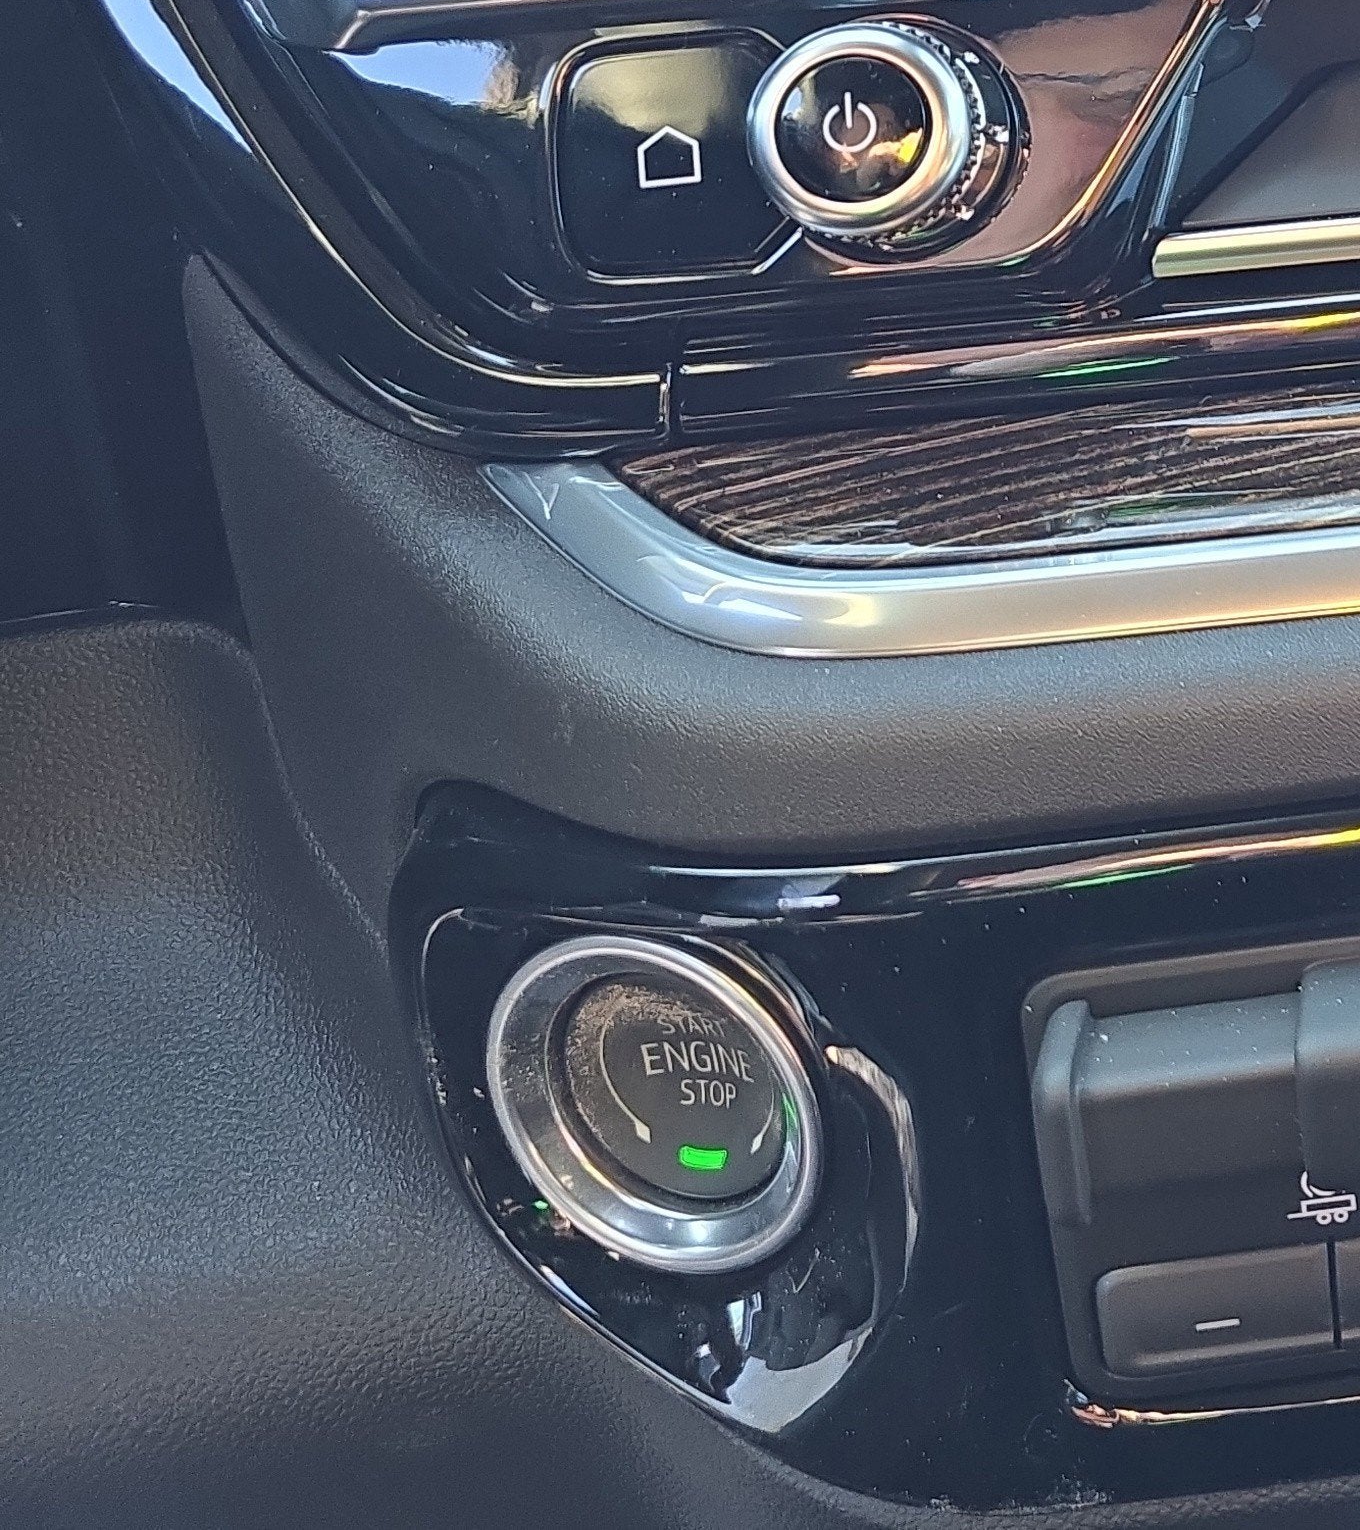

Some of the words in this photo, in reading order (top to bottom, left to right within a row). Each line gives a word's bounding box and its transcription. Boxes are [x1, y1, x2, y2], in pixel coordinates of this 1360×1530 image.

[657, 1011, 728, 1037] START
[641, 1040, 755, 1082] ENGINE
[680, 1078, 736, 1109] STOP
